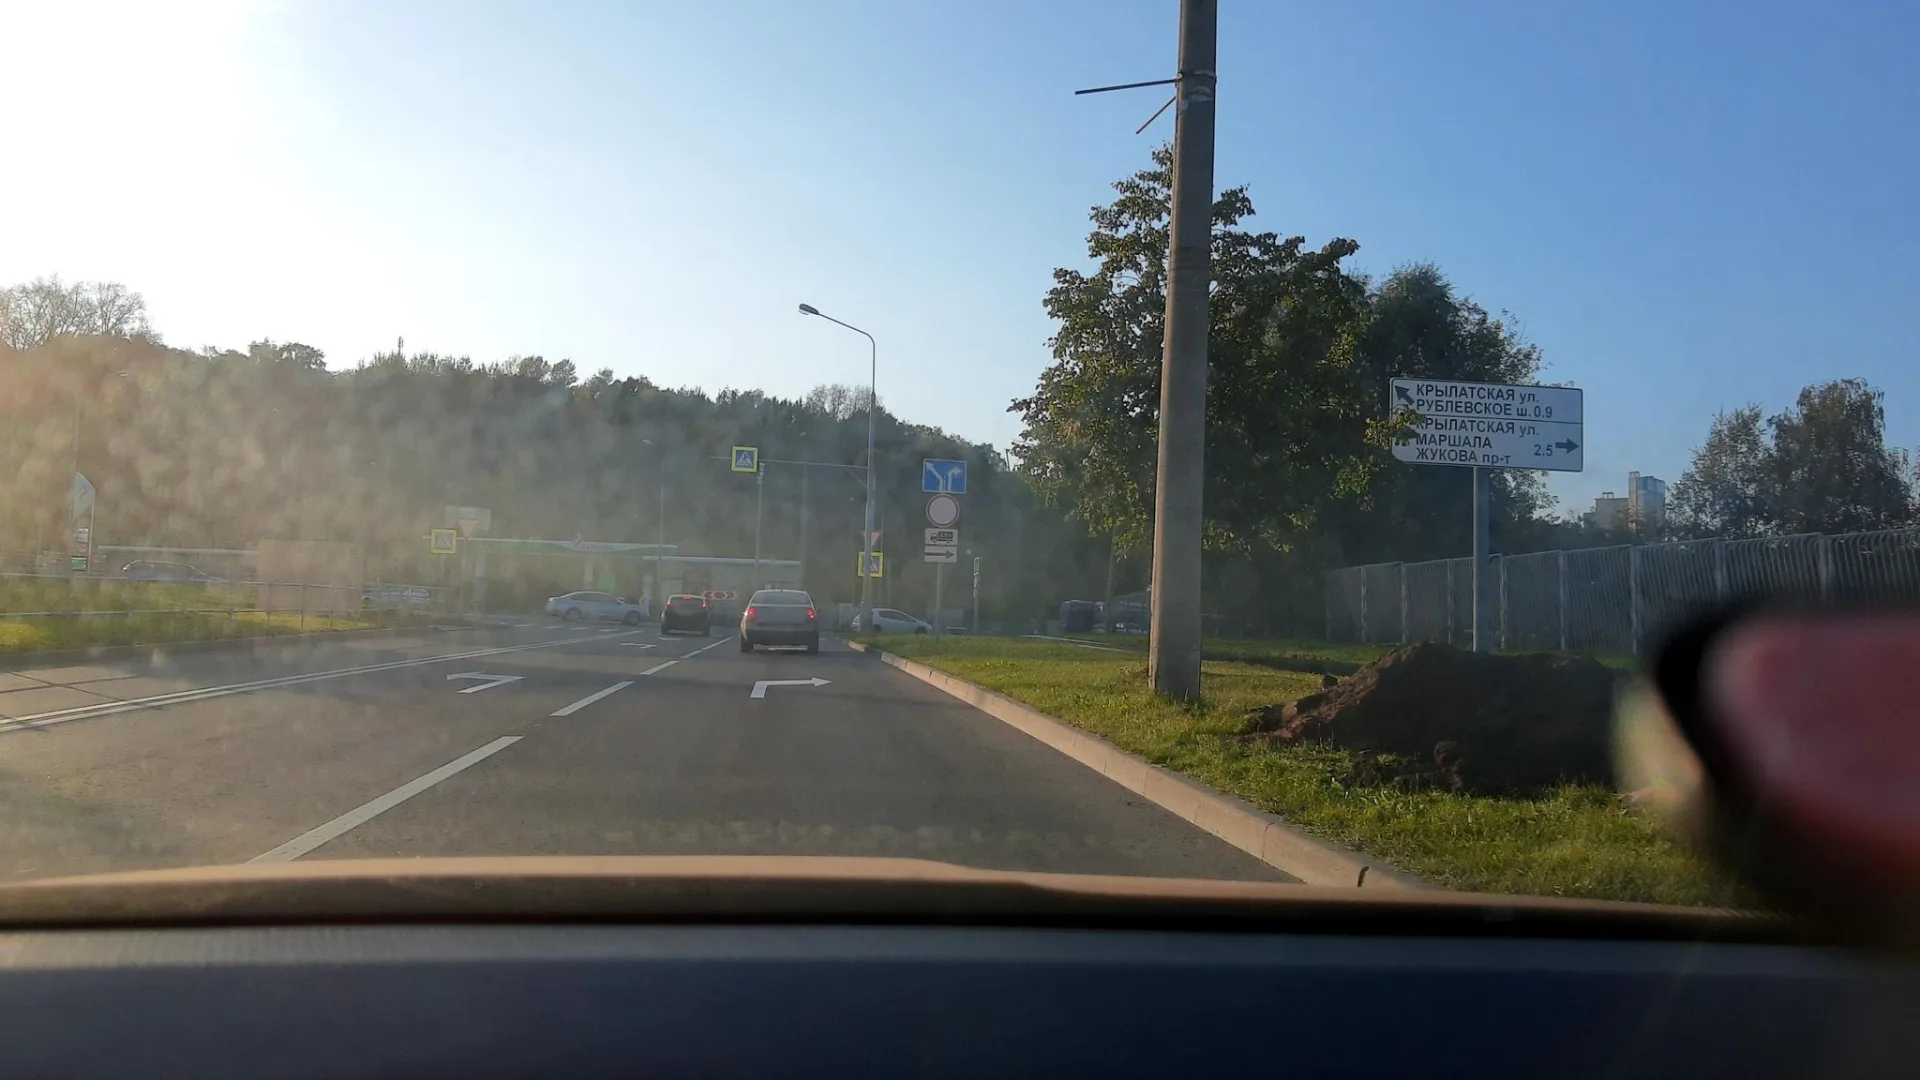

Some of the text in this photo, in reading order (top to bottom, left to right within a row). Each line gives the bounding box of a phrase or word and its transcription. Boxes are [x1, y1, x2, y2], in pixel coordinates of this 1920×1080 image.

[1416, 384, 1539, 404] КРЫЛАТСКАЯ ул.
[1416, 399, 1553, 418] РУБЛЕВСКОЕ ш. 0.9
[1519, 425, 1539, 438] ул.
[1416, 433, 1492, 449] МАРШАЛА
[1416, 447, 1511, 465] ЖУКОВА пр-т
[1534, 443, 1553, 457] 2.5
